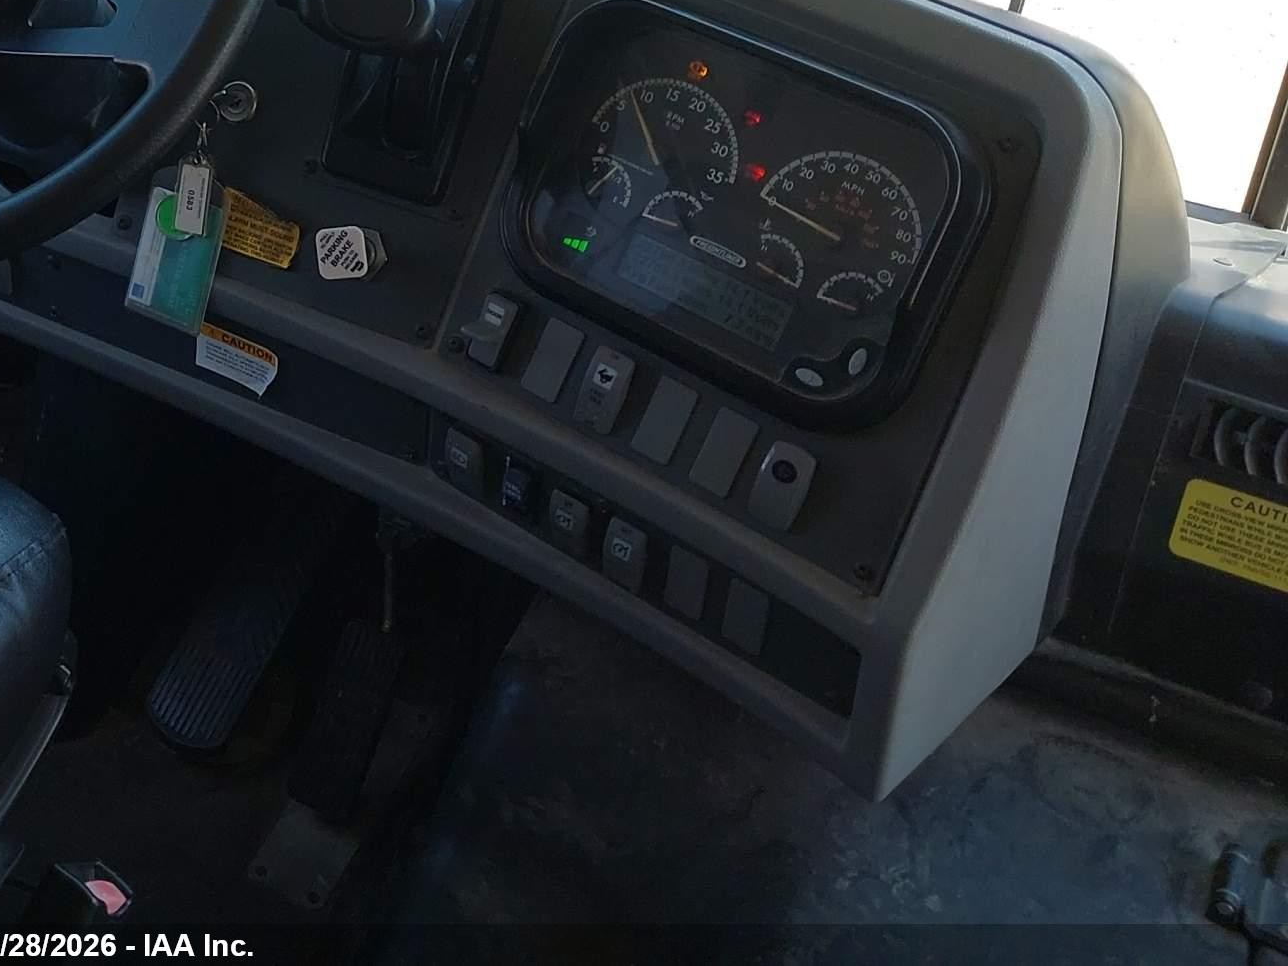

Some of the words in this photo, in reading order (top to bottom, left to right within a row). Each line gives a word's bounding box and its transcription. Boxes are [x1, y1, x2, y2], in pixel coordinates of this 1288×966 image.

[639, 90, 654, 104] 10
[665, 88, 681, 102] 15
[616, 99, 626, 112] 5
[688, 97, 706, 113] 20
[599, 121, 610, 133] 0
[703, 118, 722, 134] 25
[711, 142, 729, 157] 30
[799, 168, 814, 180] 20
[820, 161, 836, 173] 30
[843, 163, 859, 175] 40
[706, 168, 723, 184] 35
[864, 172, 881, 184] 50
[782, 179, 794, 191] 10
[841, 181, 866, 195] MPH
[881, 187, 898, 201] 60
[768, 197, 776, 206] 0
[889, 206, 908, 221] 70
[895, 230, 912, 243] 80
[319, 229, 349, 264] PARKING
[329, 239, 354, 267] BRAKE
[889, 251, 907, 265] 90
[221, 333, 274, 363] CAUTION
